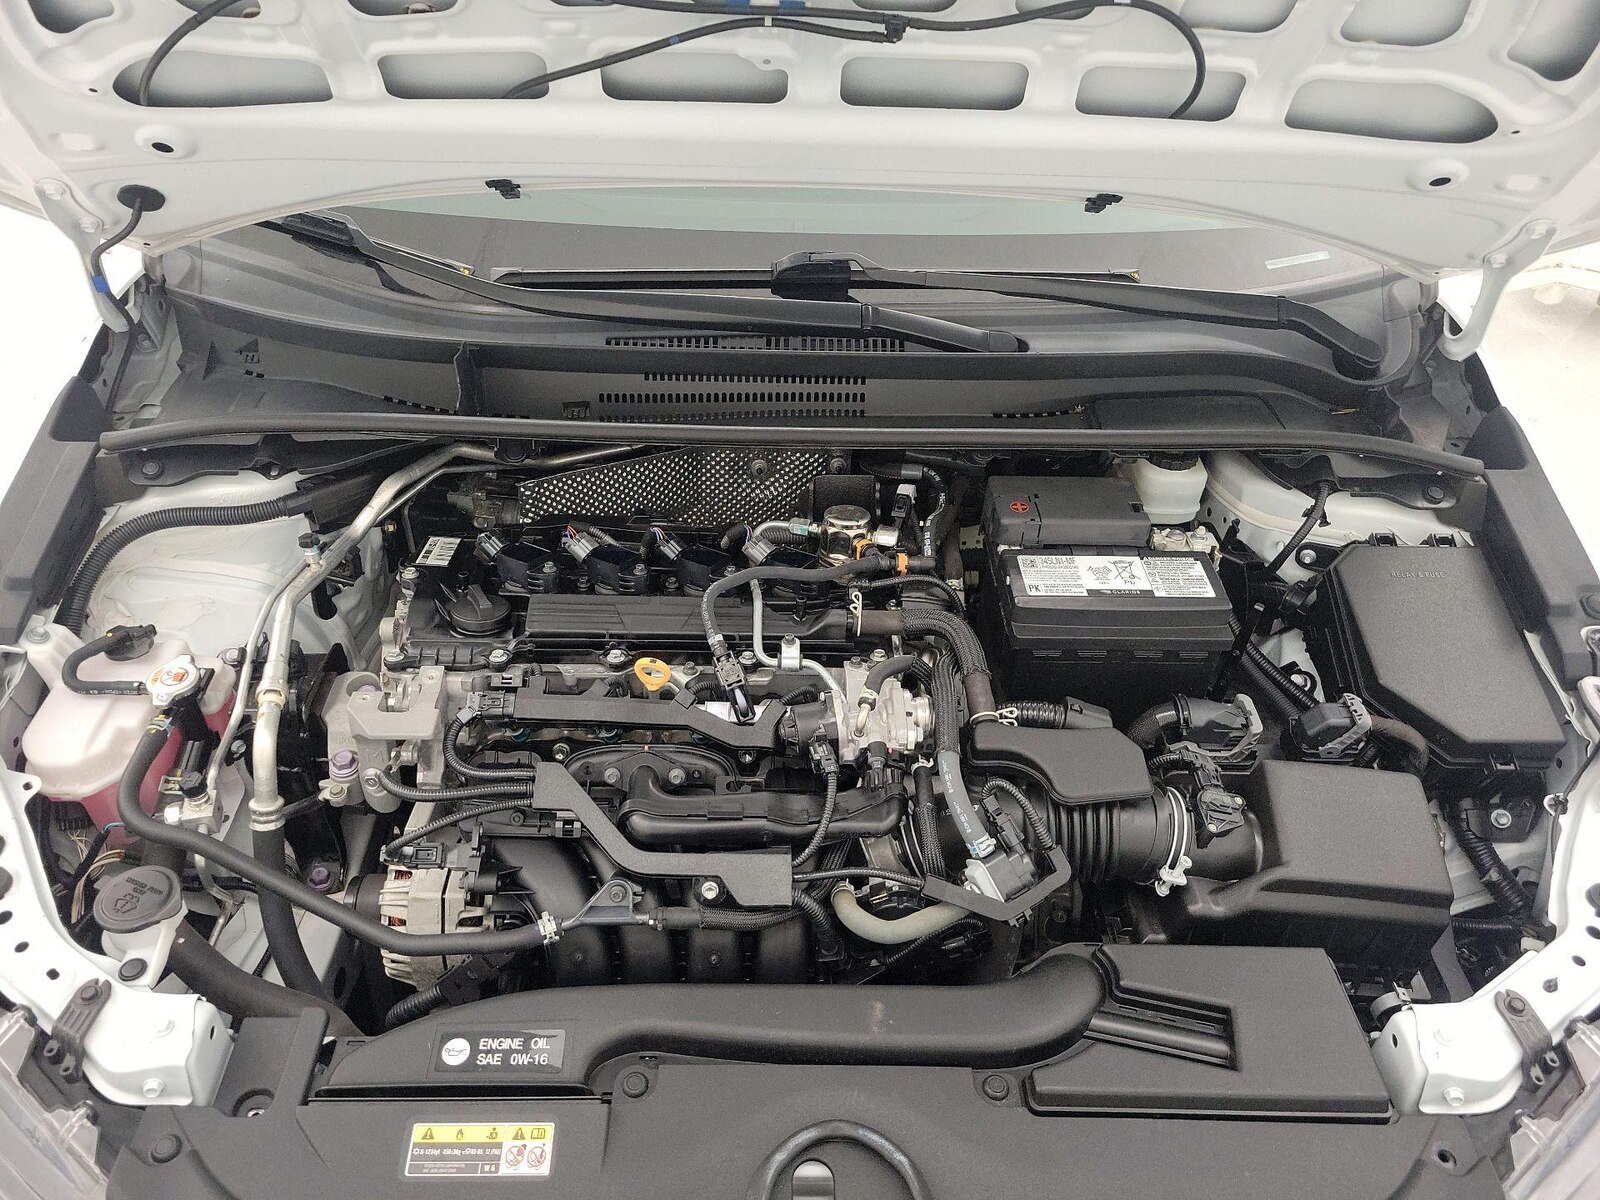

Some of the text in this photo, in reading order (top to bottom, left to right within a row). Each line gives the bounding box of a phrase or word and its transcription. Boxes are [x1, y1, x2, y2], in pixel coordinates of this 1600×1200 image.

[1390, 571, 1415, 579] RELAY
[1425, 571, 1446, 579] FUSE
[1028, 584, 1041, 592] PK
[478, 1037, 551, 1050] ENGINE OIL
[476, 1053, 549, 1065] SAE 0W-16
